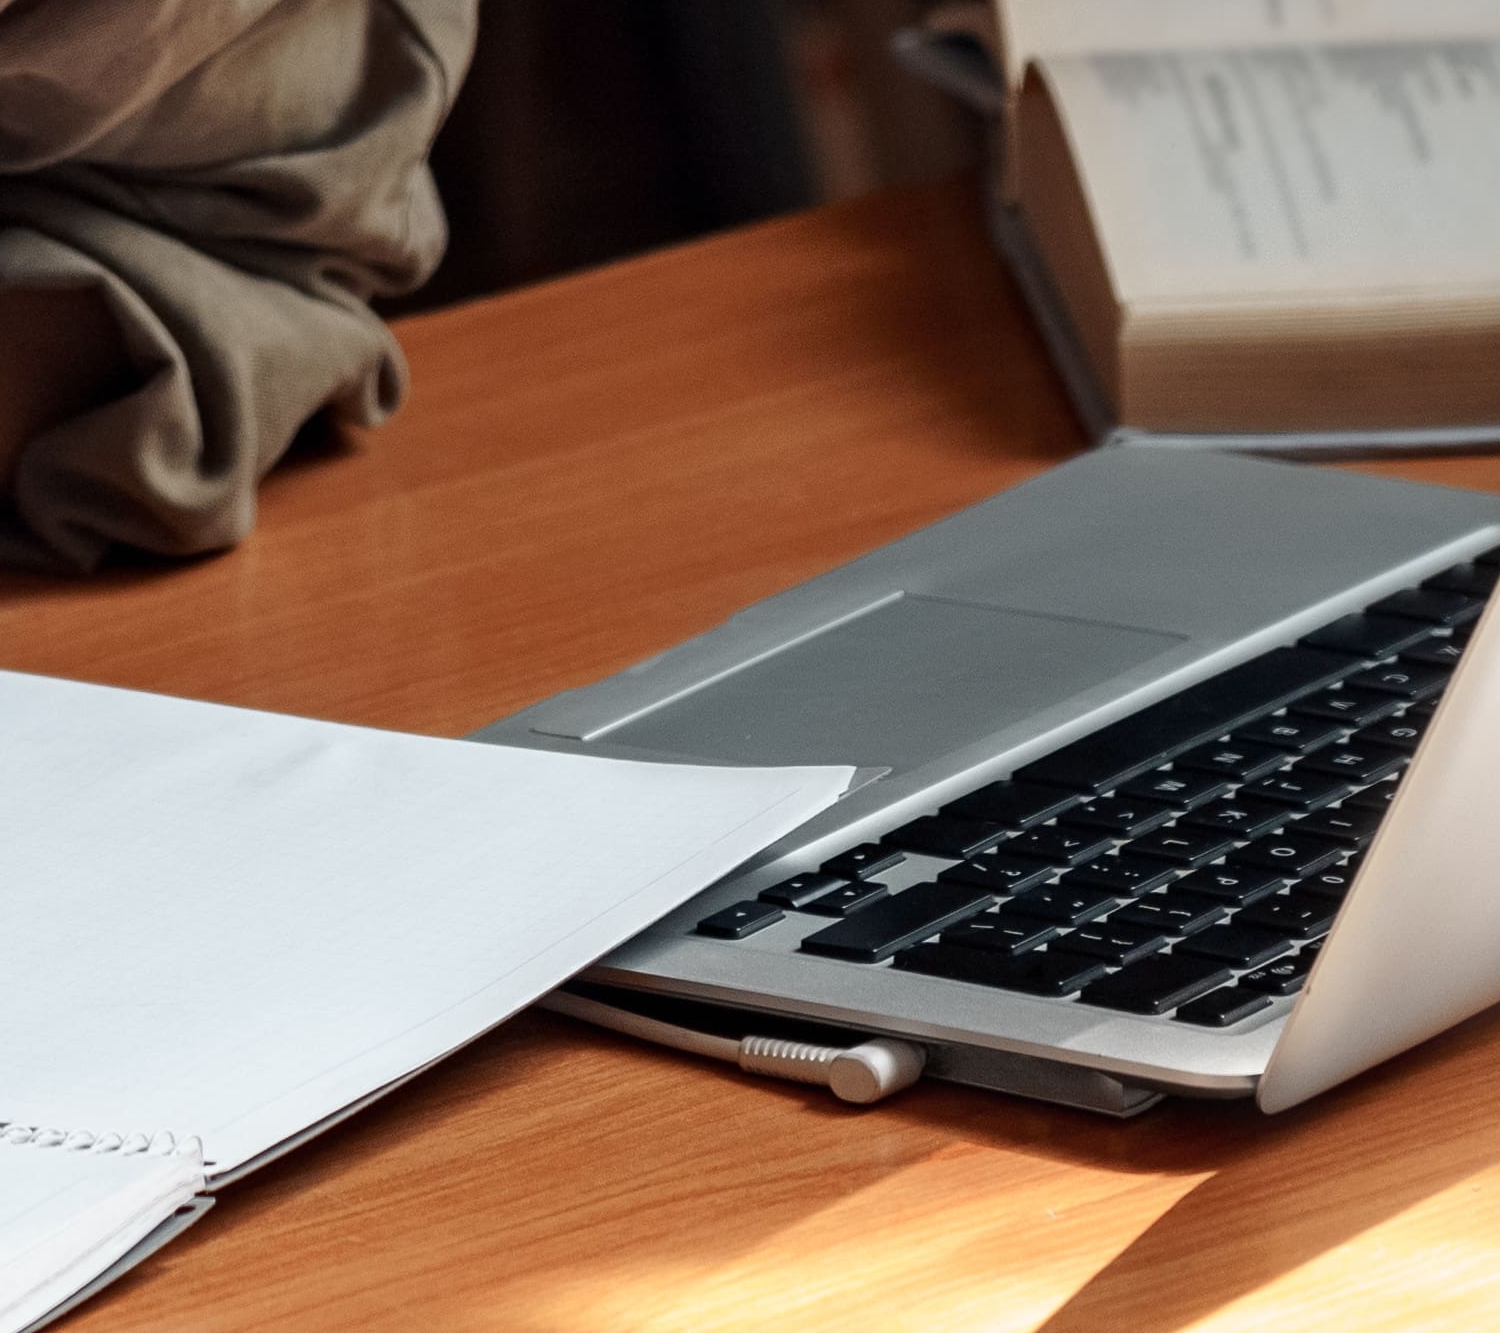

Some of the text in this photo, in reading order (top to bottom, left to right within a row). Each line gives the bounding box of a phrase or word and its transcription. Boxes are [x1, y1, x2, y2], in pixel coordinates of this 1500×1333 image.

[1382, 673, 1410, 684] C
[1391, 727, 1418, 738] G
[1213, 752, 1244, 764] N
[1333, 753, 1364, 765] H
[1154, 780, 1187, 792] M
[1216, 876, 1239, 886] P
